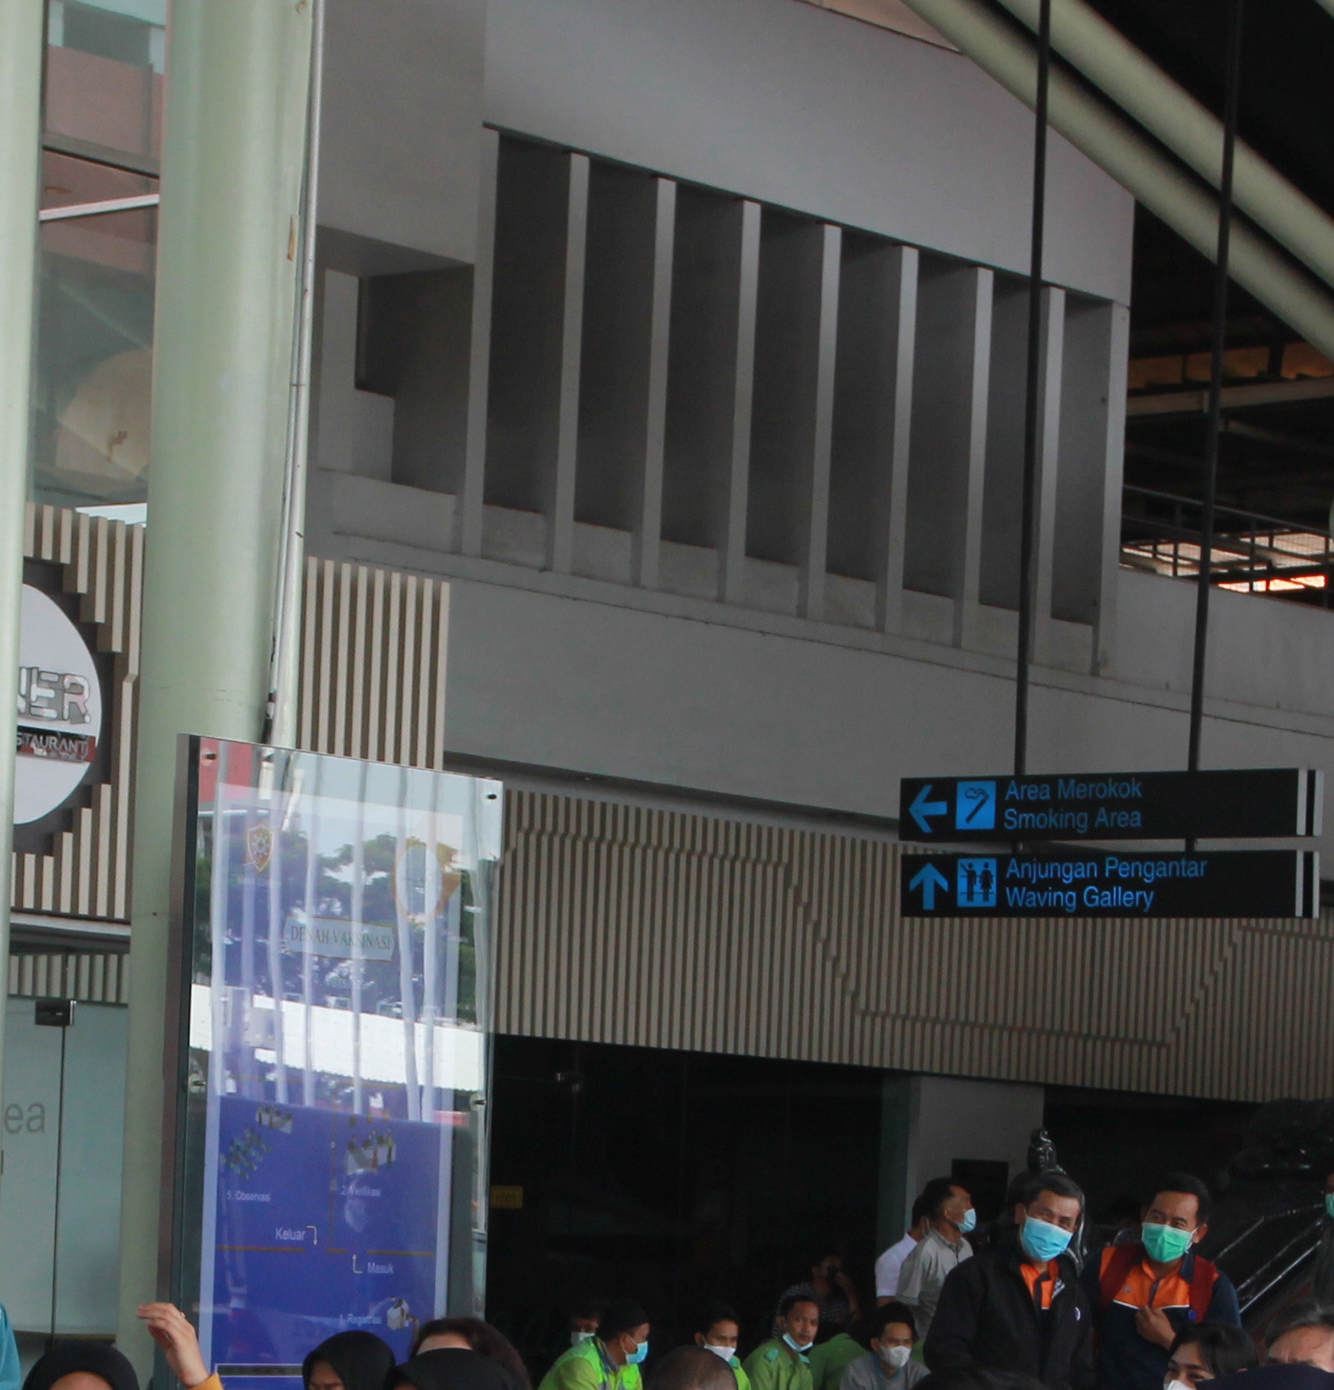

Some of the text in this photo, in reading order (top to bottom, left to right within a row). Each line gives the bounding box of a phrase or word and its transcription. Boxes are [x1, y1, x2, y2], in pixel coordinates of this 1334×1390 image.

[1005, 777, 1142, 800] Area Merokok
[1005, 807, 1142, 833] Smoking Area
[1006, 857, 1208, 885] Anjungan Pengantar
[1006, 885, 1155, 913] Waving Gallery
[291, 924, 391, 950] DENAH VAKSINASI
[275, 1227, 306, 1241] Keluar
[367, 1261, 394, 1275] Masuk
